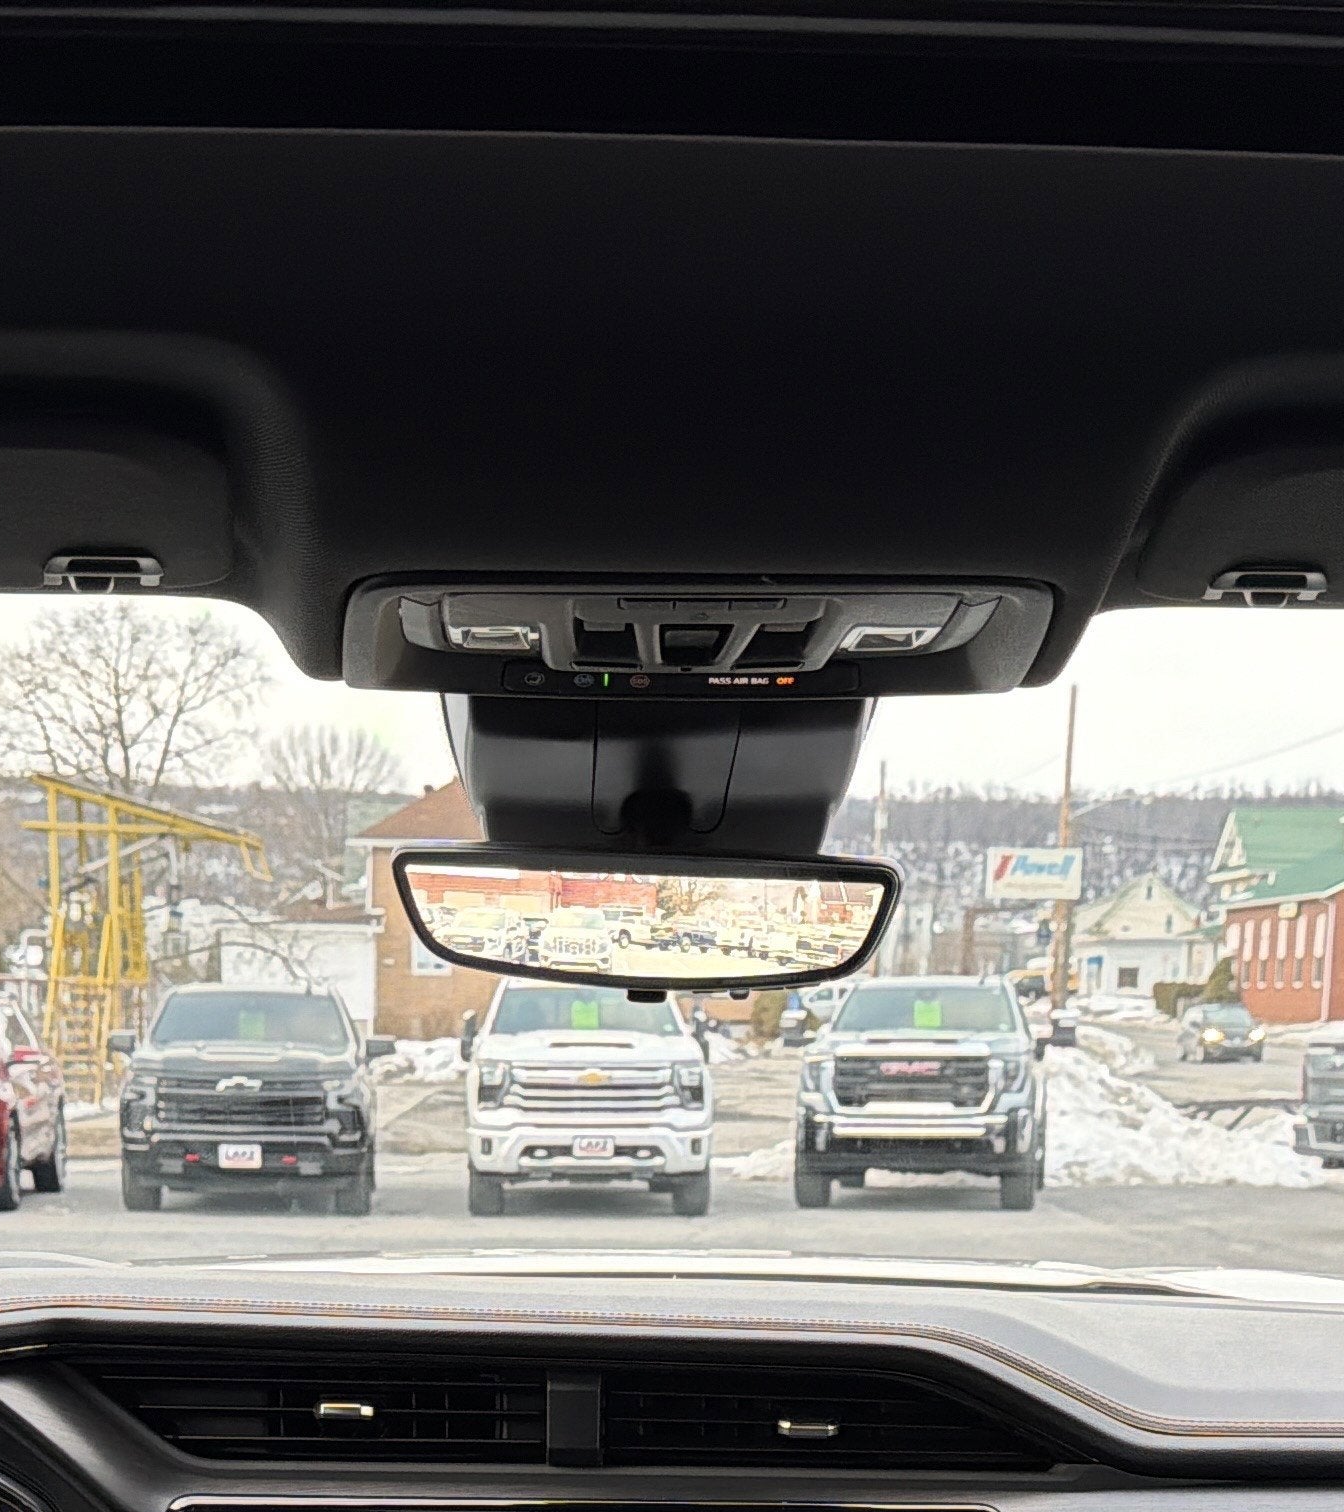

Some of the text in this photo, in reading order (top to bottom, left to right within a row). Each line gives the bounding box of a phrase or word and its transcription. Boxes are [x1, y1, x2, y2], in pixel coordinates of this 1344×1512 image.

[708, 677, 795, 685] PASS AIR BAG OFF
